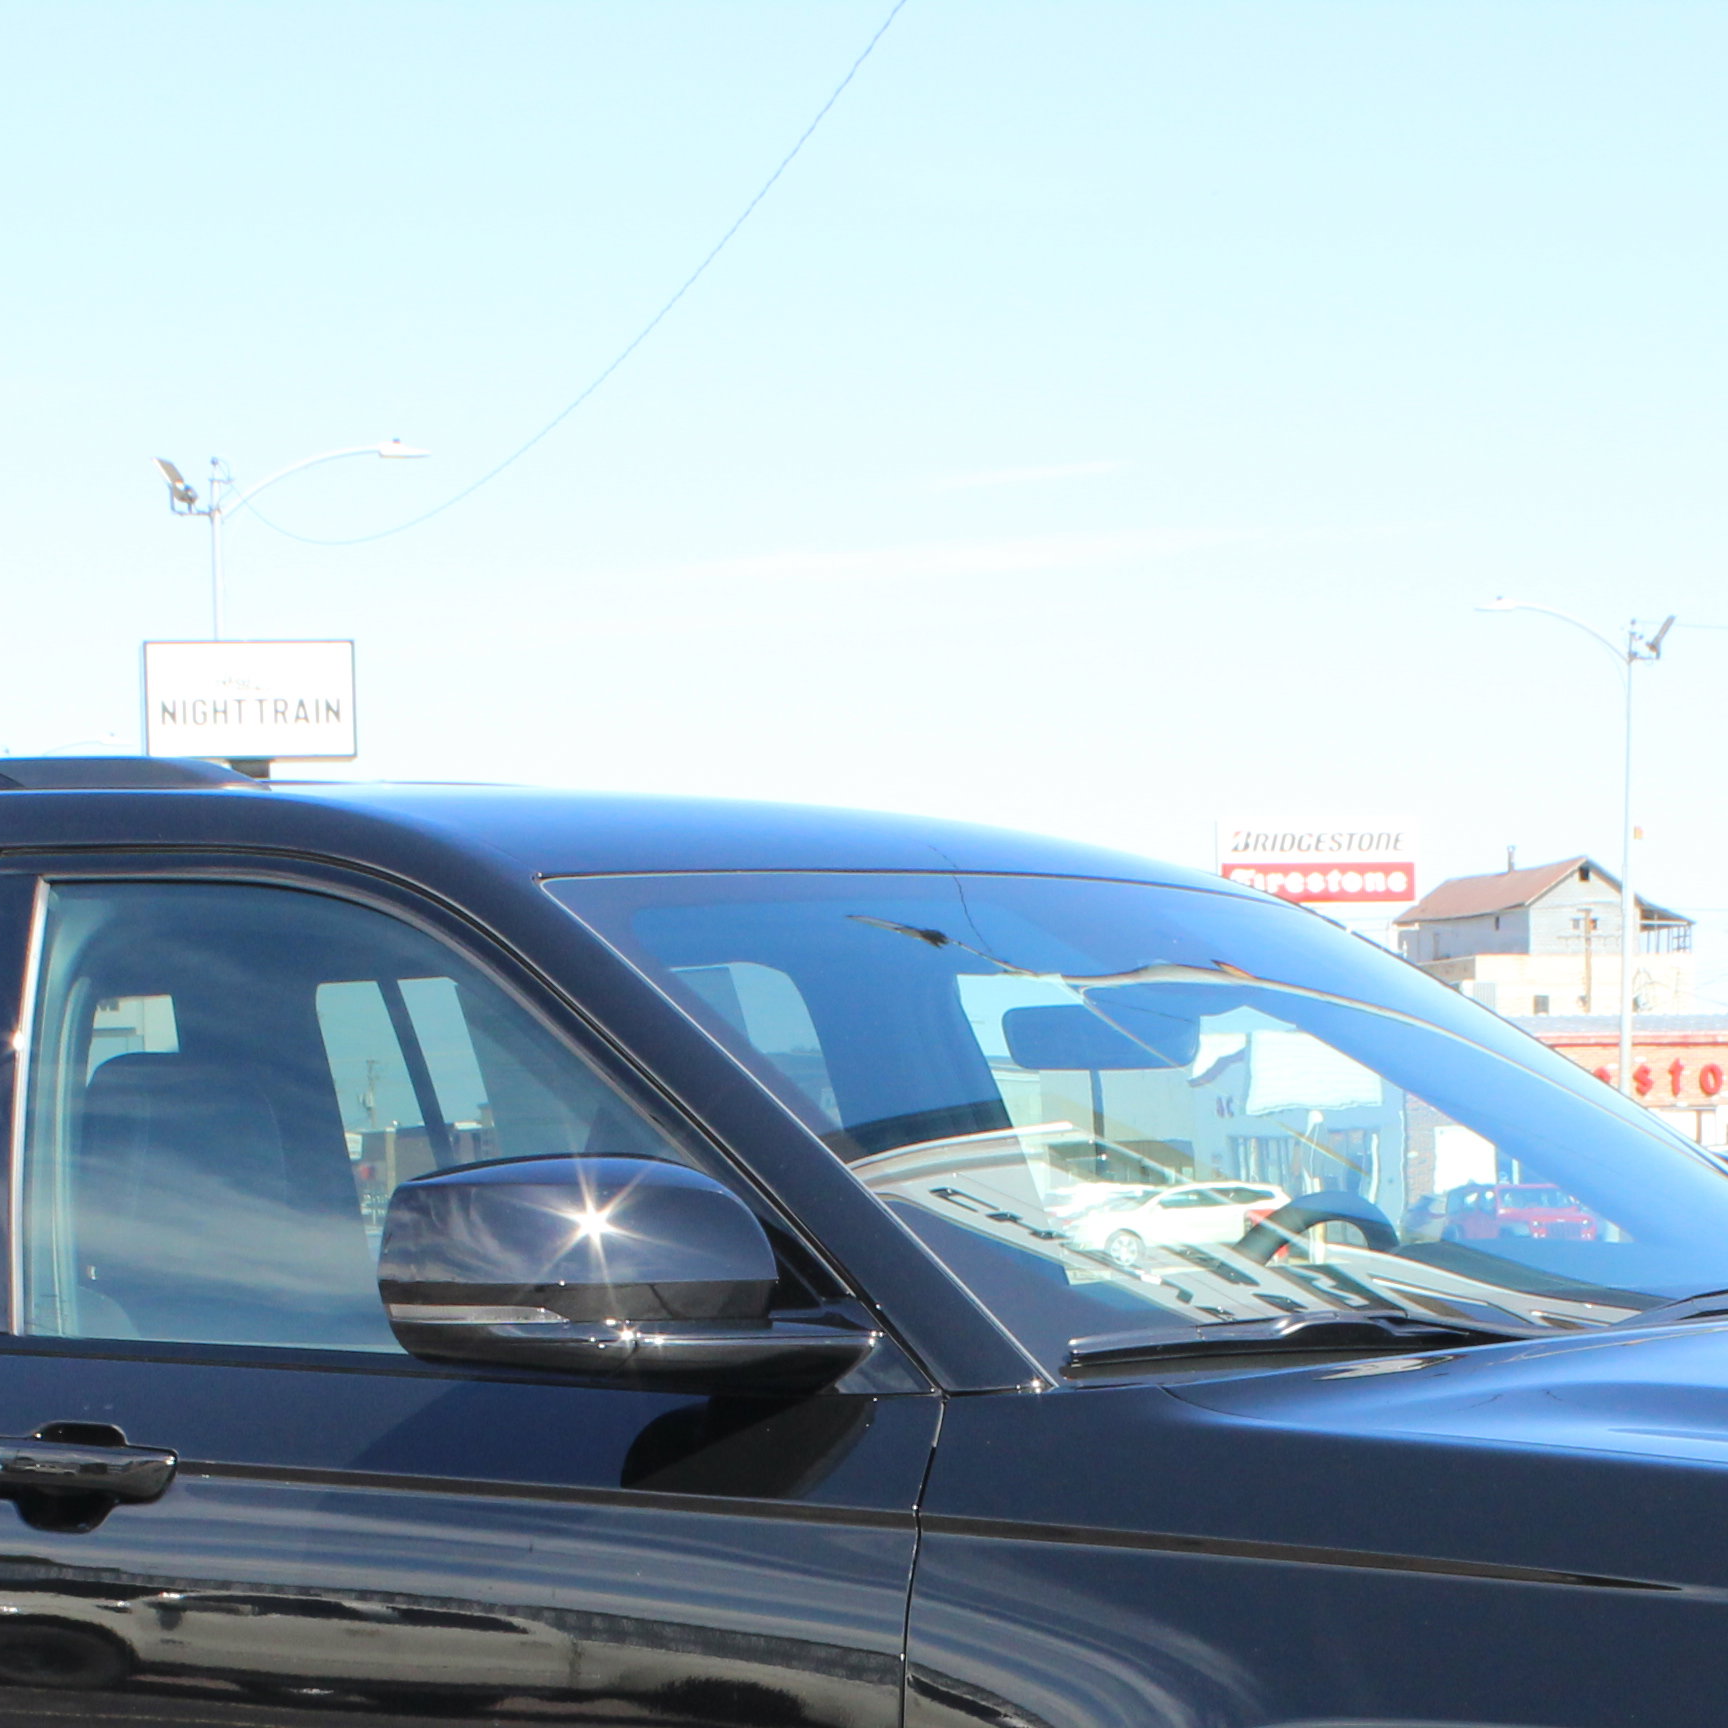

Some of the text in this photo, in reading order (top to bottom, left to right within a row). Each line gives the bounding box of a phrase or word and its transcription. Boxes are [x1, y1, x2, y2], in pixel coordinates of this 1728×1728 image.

[161, 698, 341, 725] NIGHT TRAIN
[1231, 831, 1406, 852] BRIDGESTONE
